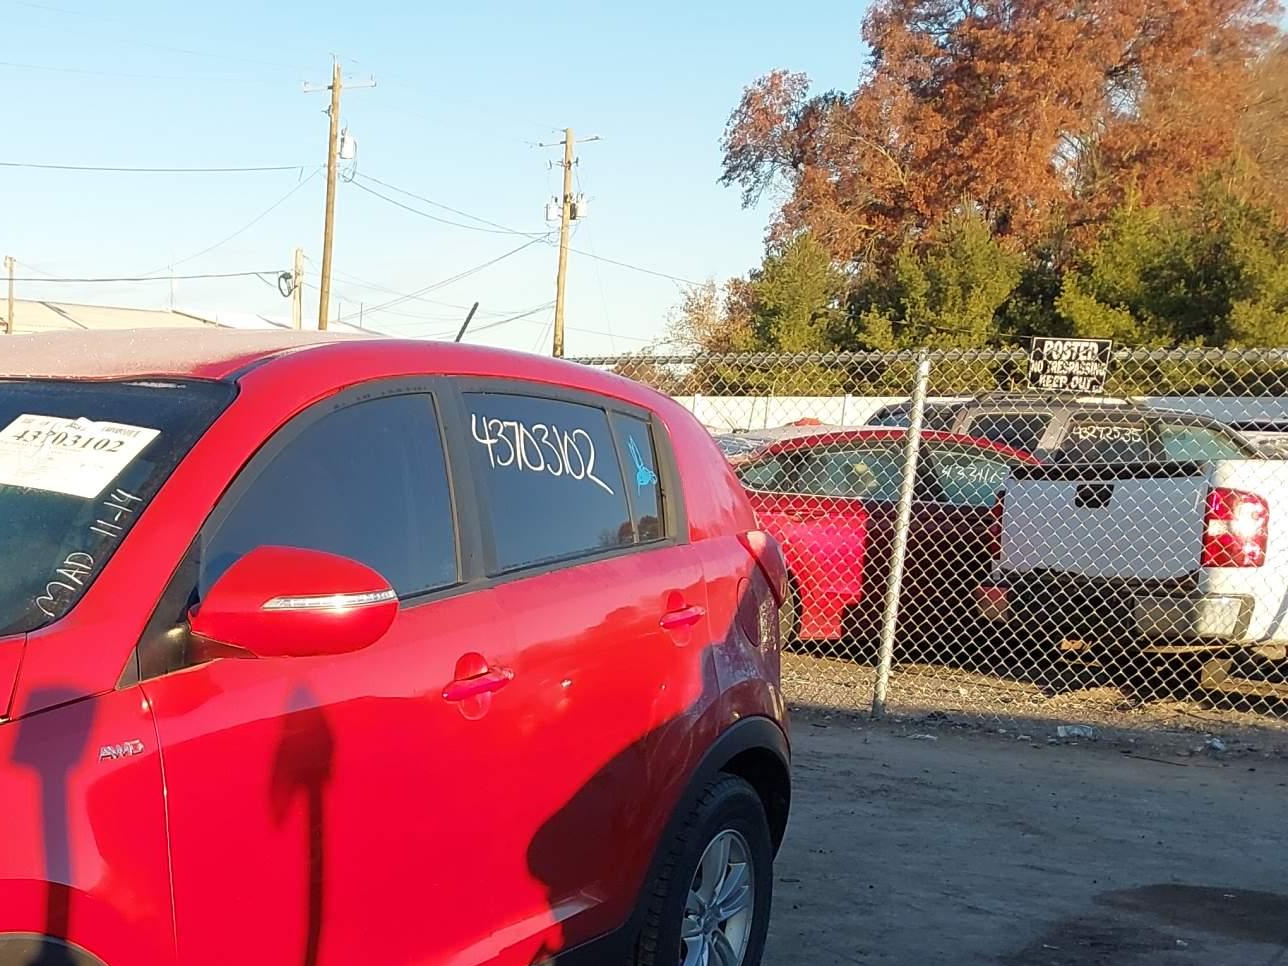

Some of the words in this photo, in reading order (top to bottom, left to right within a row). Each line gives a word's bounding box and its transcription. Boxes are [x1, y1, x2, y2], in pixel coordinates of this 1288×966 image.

[1043, 340, 1099, 360] POSTED
[1031, 360, 1044, 373] NO
[1047, 360, 1107, 376] TRESPASSING
[1039, 374, 1068, 388] KEEP
[1070, 376, 1094, 390] OUT
[13, 429, 125, 453] 43703102
[472, 413, 615, 496] 43703102
[36, 552, 94, 617] MAD
